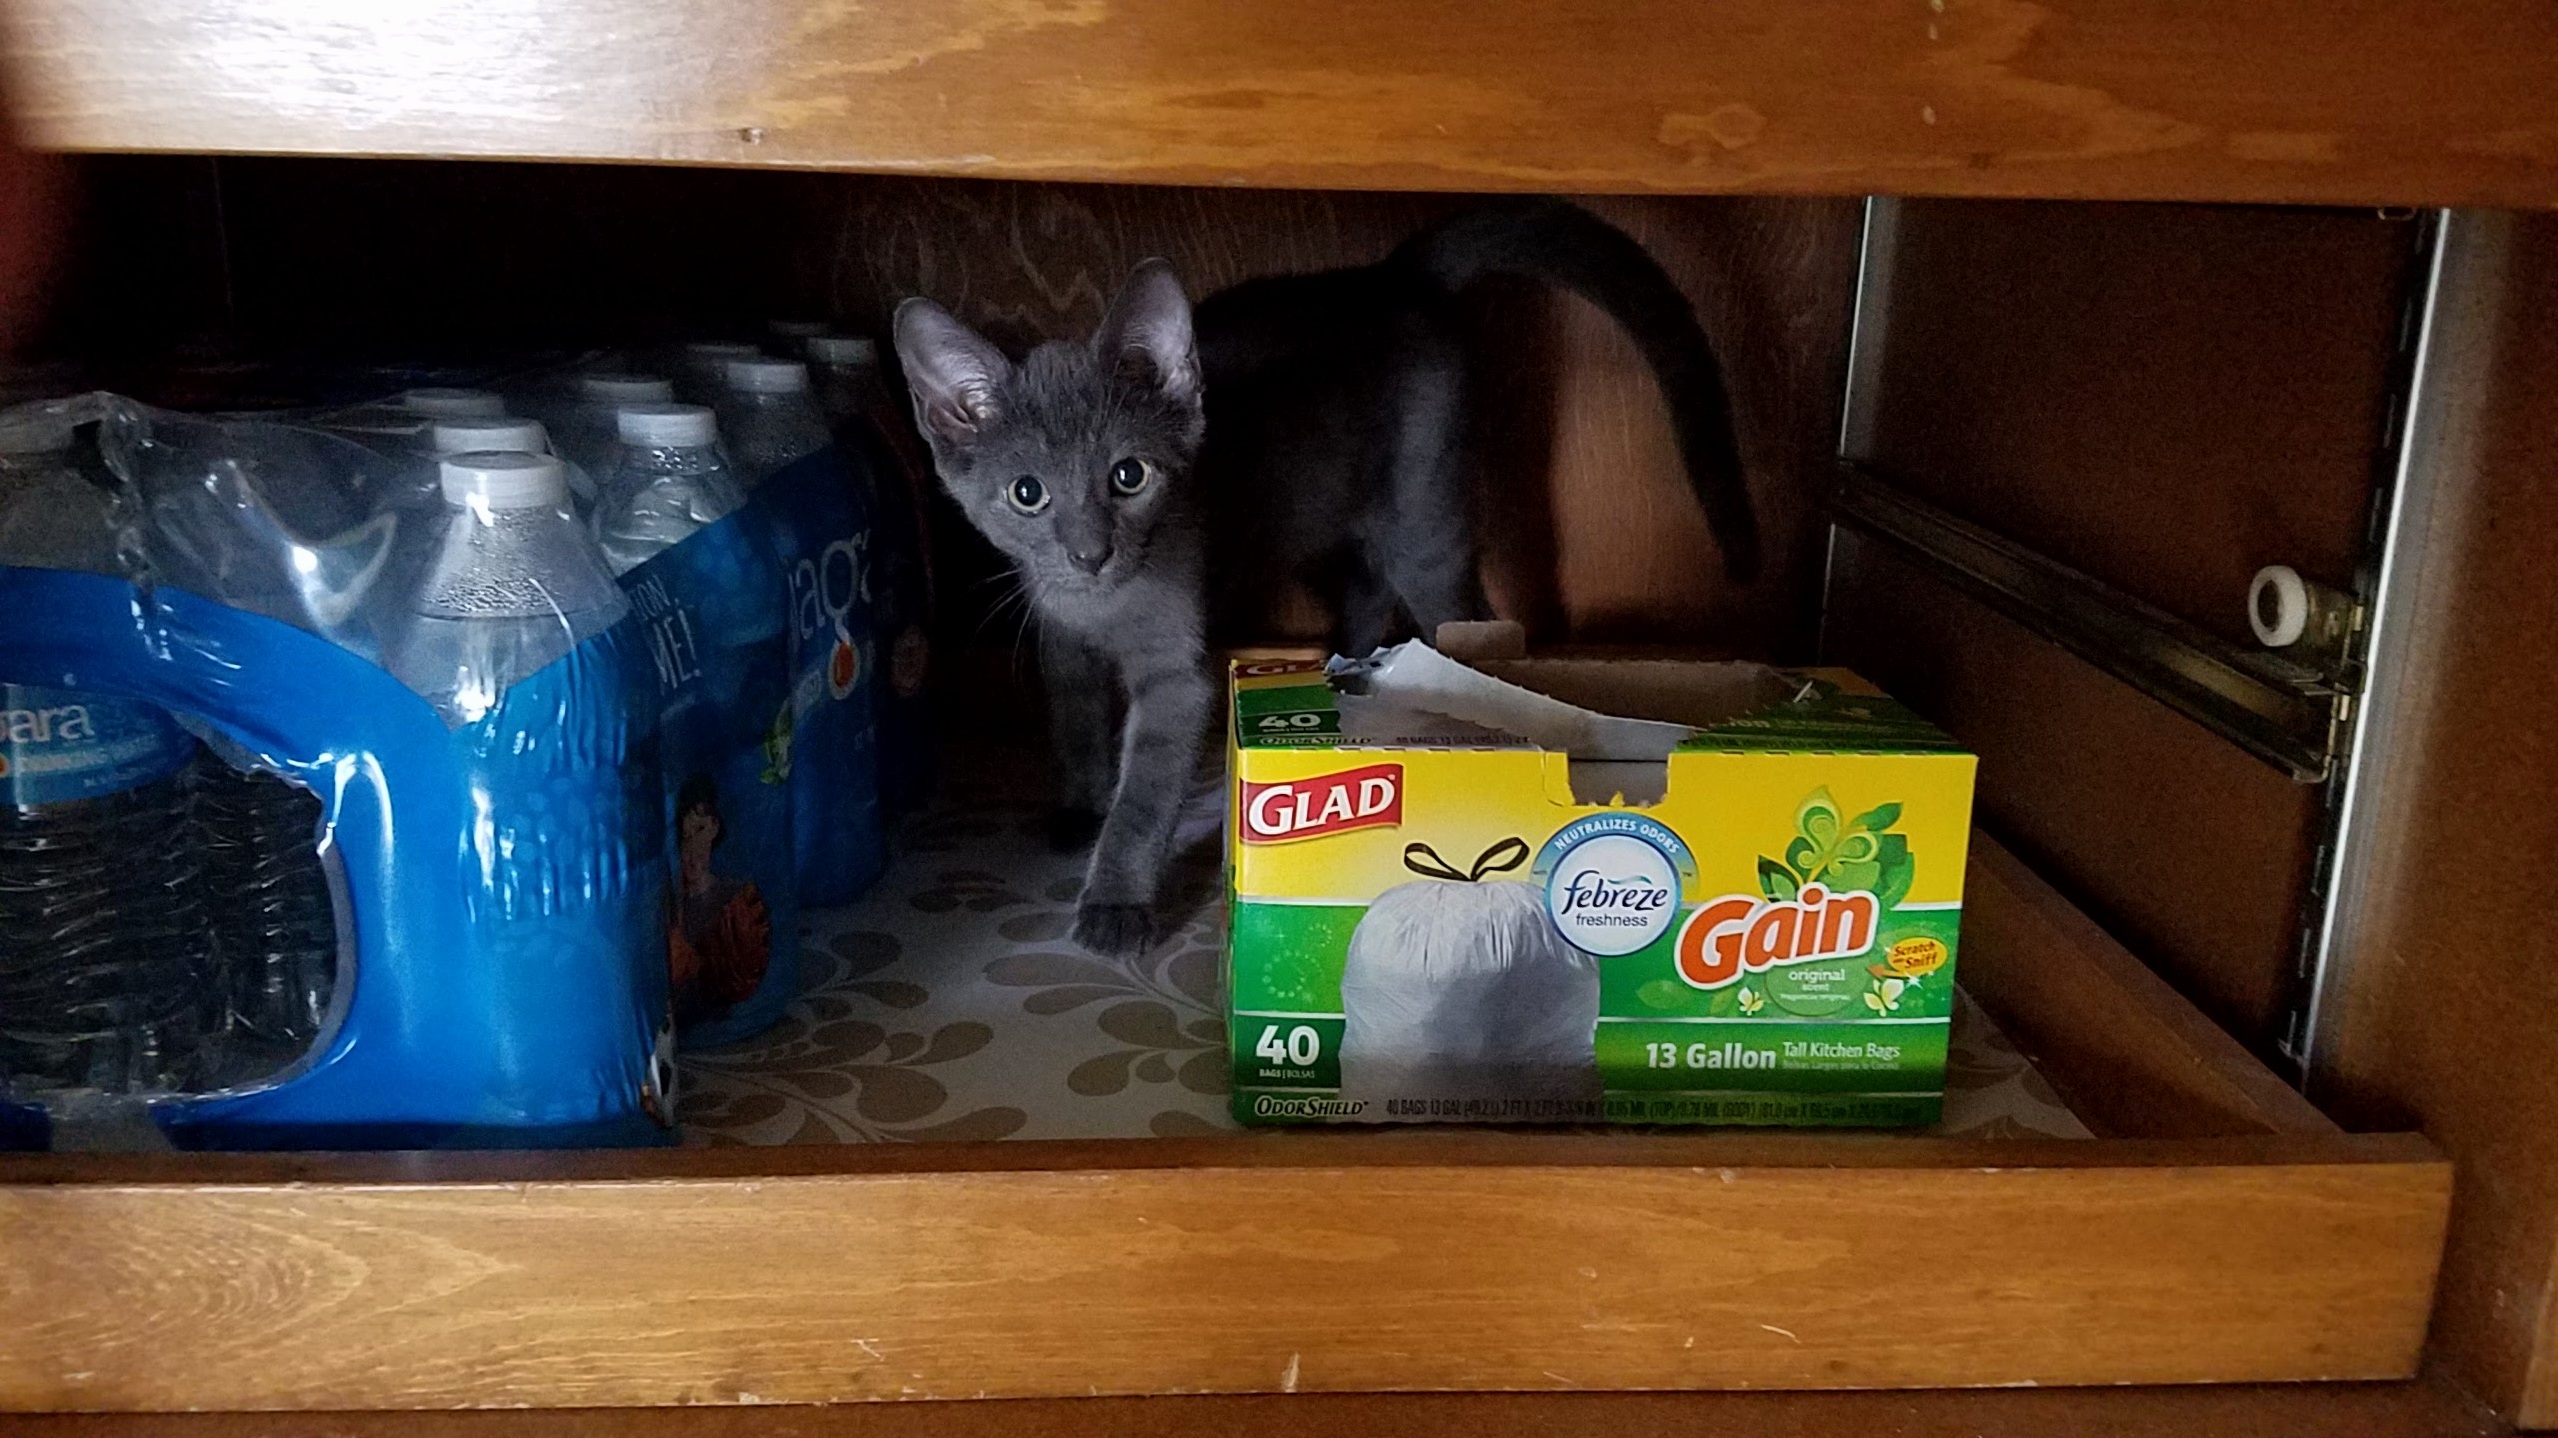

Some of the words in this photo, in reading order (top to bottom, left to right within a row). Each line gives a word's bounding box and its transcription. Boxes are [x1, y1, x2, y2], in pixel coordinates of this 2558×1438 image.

[1258, 714, 1321, 727] 40
[1249, 776, 1395, 835] GLAD
[1554, 819, 1637, 850] NEUTRALIZES
[1640, 824, 1680, 853] ODORS
[1561, 870, 1668, 915] febreze
[1576, 913, 1648, 926] freshness
[1678, 885, 1874, 986] Gain
[1893, 941, 1936, 957] Scratch
[1904, 953, 1937, 969] Sniff
[1788, 968, 1846, 983] original
[1256, 1025, 1320, 1066] 40
[1782, 1042, 1807, 1057] Tall
[1810, 1042, 1863, 1057] Kitchen
[1866, 1042, 1901, 1061] Bags
[1646, 1043, 1677, 1068] 13
[1686, 1042, 1776, 1069] Gallon
[1387, 1099, 1398, 1116] 40
[1401, 1099, 1426, 1116] BAGS
[1430, 1099, 1440, 1116] 13
[1443, 1099, 1461, 1116] GAL
